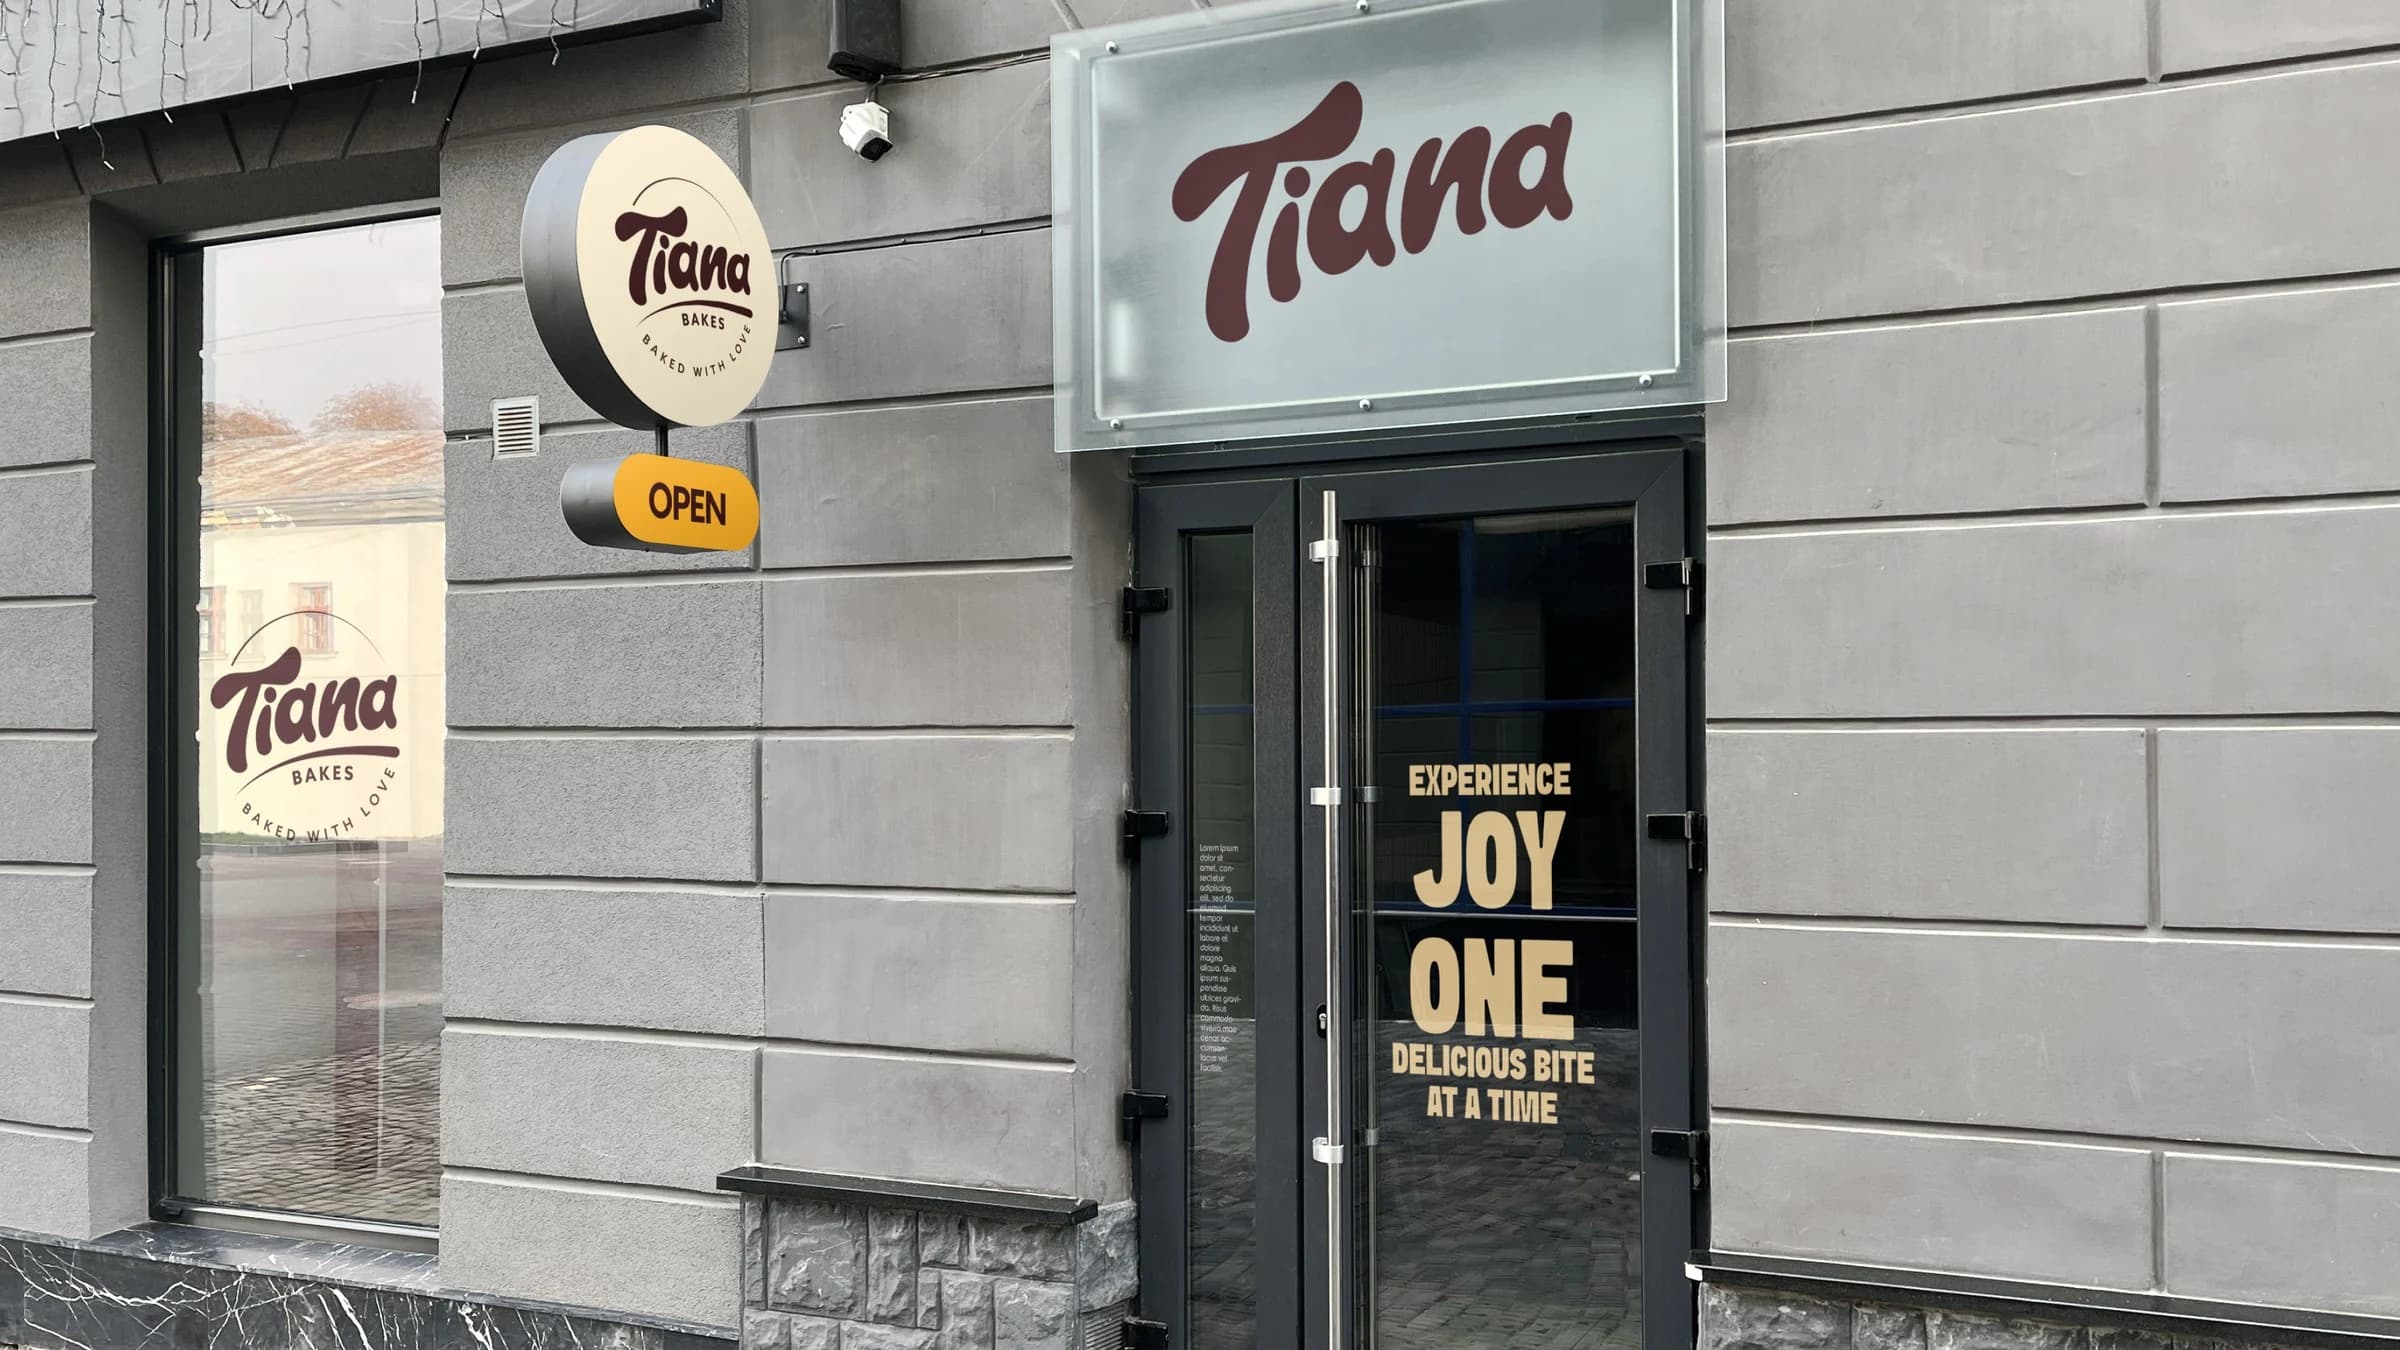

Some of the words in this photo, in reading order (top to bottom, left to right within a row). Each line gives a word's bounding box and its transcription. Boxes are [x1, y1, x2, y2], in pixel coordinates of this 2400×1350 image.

[1171, 80, 1573, 343] Tiana
[614, 206, 751, 306] Tiana
[682, 312, 725, 331] BAKES
[642, 333, 686, 375] BAKED
[693, 359, 726, 377] WITH
[729, 324, 751, 362] LOVE
[649, 482, 726, 526] OPEN
[210, 646, 397, 773] Tiana
[292, 765, 354, 786] BAKES
[1408, 762, 1571, 797] EXPERIENCE
[242, 802, 296, 841] BAKED
[307, 817, 354, 843] WITH
[360, 767, 395, 817] LOVE
[1413, 810, 1566, 910] JOY
[1409, 937, 1574, 1040] ONE
[1392, 1042, 1527, 1081] DELICIOUS
[1534, 1049, 1595, 1085] BITE
[1427, 1085, 1458, 1118] AT
[1464, 1087, 1481, 1120] A
[1487, 1088, 1558, 1124] TIME
